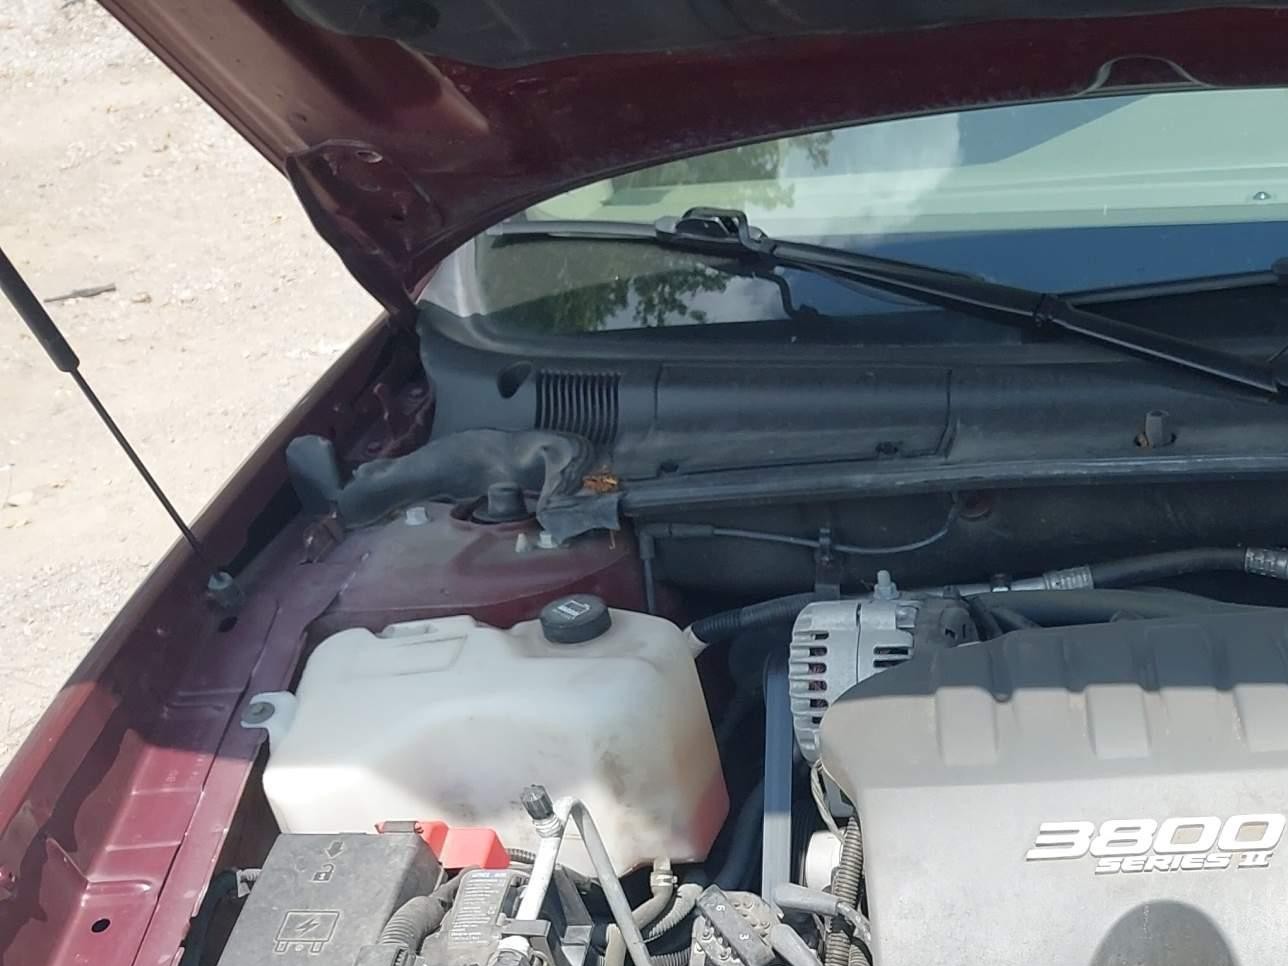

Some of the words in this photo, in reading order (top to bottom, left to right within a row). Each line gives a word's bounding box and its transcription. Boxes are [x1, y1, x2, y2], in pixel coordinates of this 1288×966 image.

[1026, 813, 1287, 861] 3800
[1094, 852, 1233, 875] SERIES
[1237, 851, 1275, 869] II
